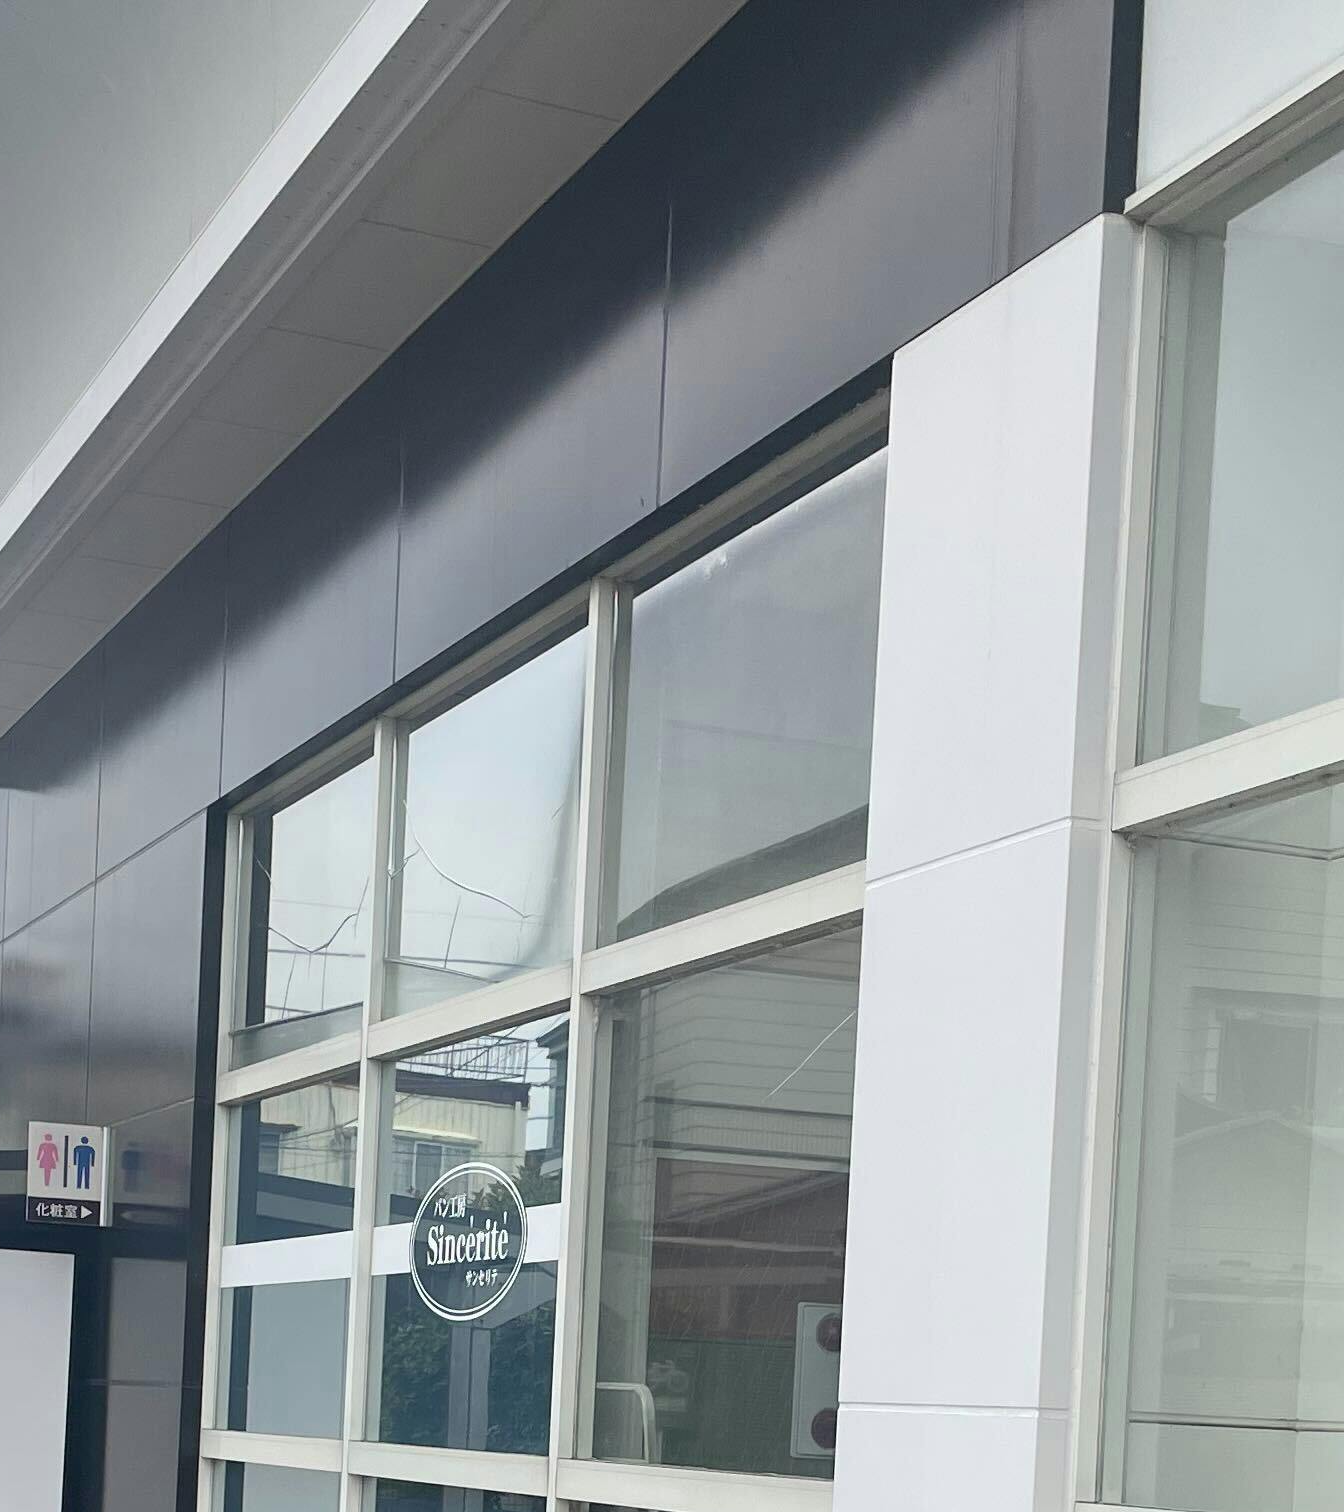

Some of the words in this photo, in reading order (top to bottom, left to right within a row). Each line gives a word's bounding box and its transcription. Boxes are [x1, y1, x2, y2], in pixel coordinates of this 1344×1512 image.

[35, 1202, 78, 1219] 化粧室
[433, 1193, 467, 1218] パン工房
[465, 1269, 498, 1288] サンセリテ
